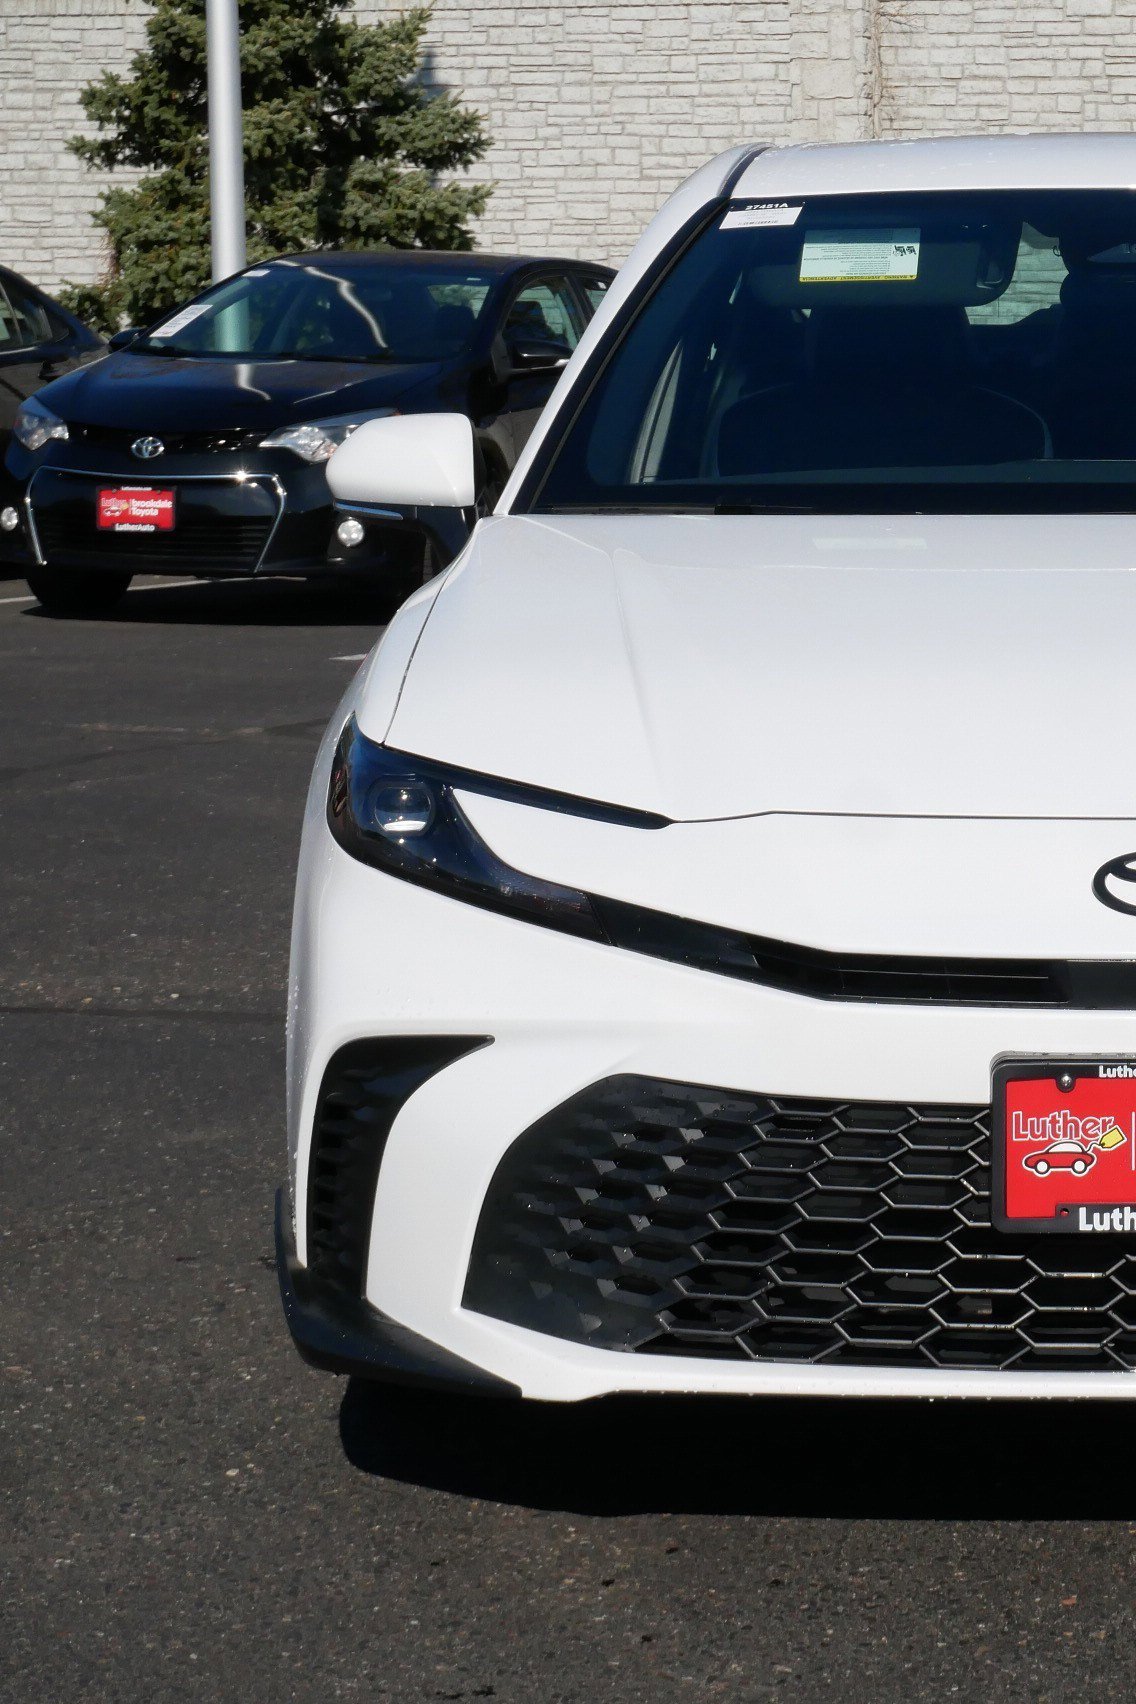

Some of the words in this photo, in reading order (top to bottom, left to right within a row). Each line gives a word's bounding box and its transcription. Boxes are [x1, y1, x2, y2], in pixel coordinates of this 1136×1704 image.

[132, 498, 173, 508] brookdale
[131, 507, 159, 517] Toyota
[1012, 1110, 1114, 1142] Luther
